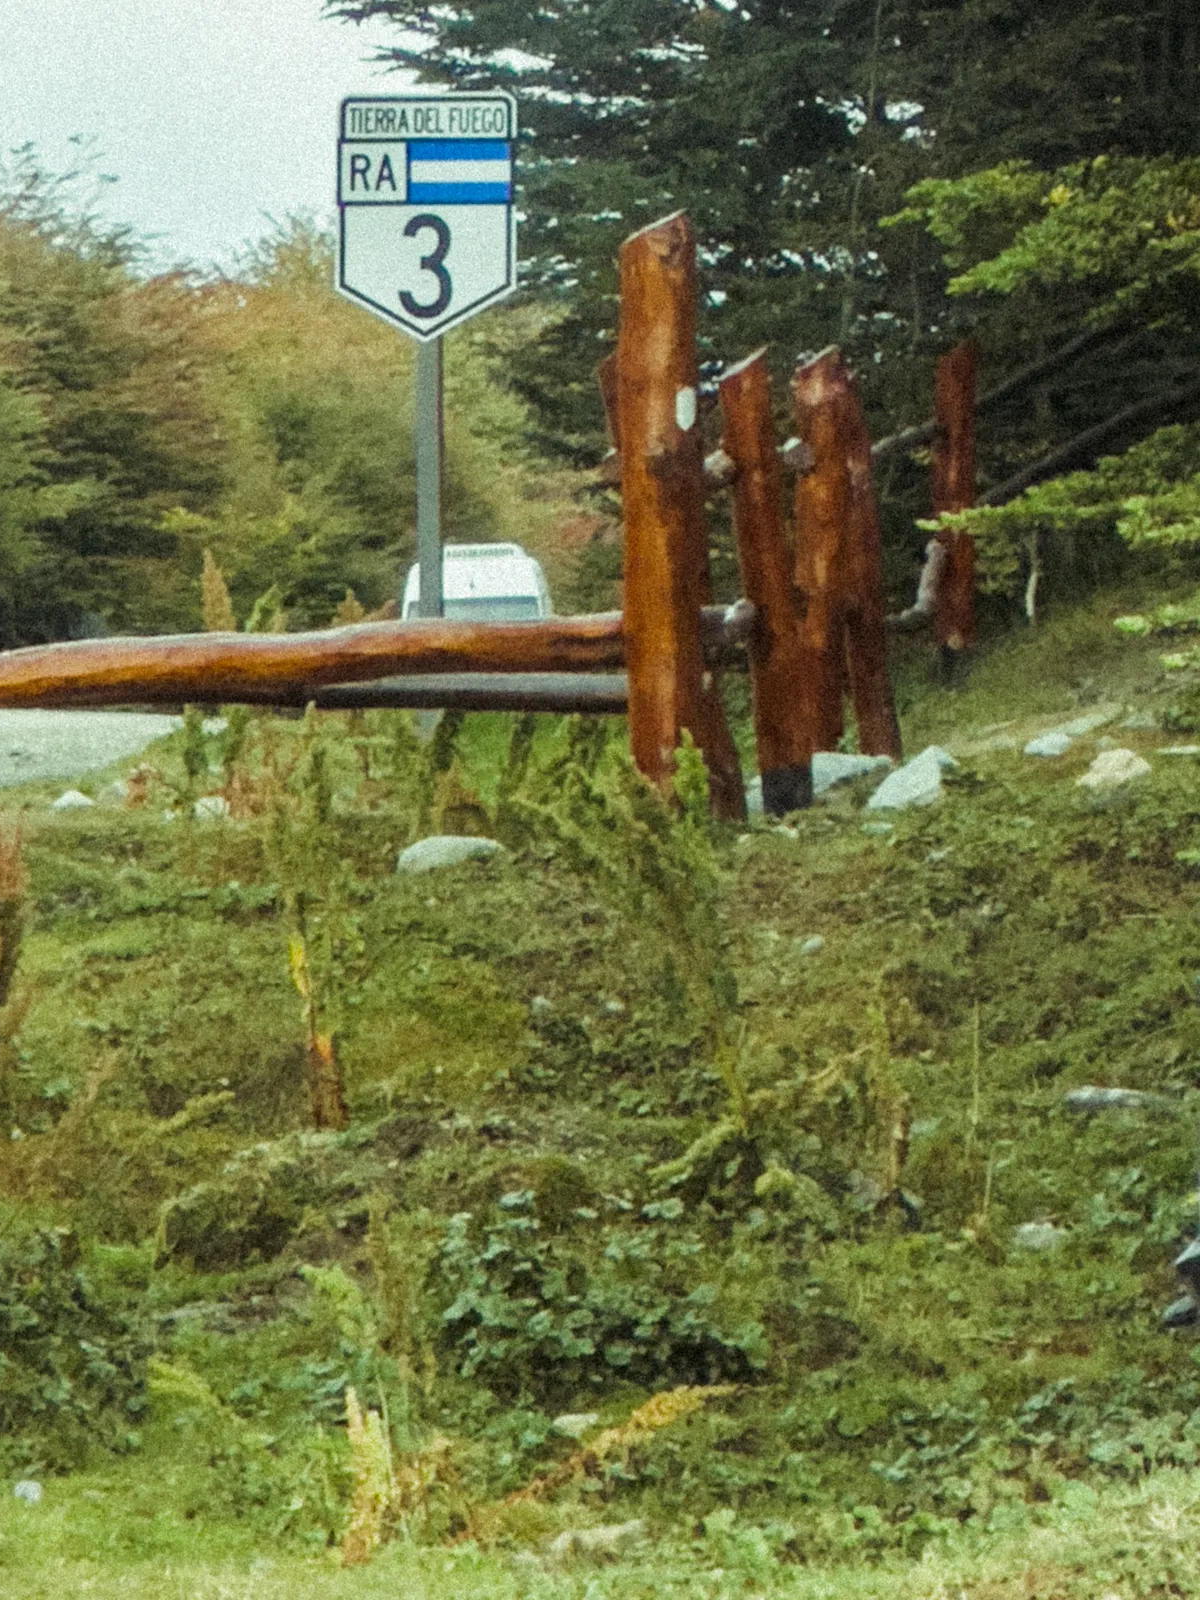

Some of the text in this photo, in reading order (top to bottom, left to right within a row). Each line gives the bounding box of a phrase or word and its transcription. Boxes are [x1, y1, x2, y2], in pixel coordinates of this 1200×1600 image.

[350, 108, 504, 133] TIERRA DEL FUEGO
[350, 154, 397, 192] RA
[398, 214, 452, 318] 3
